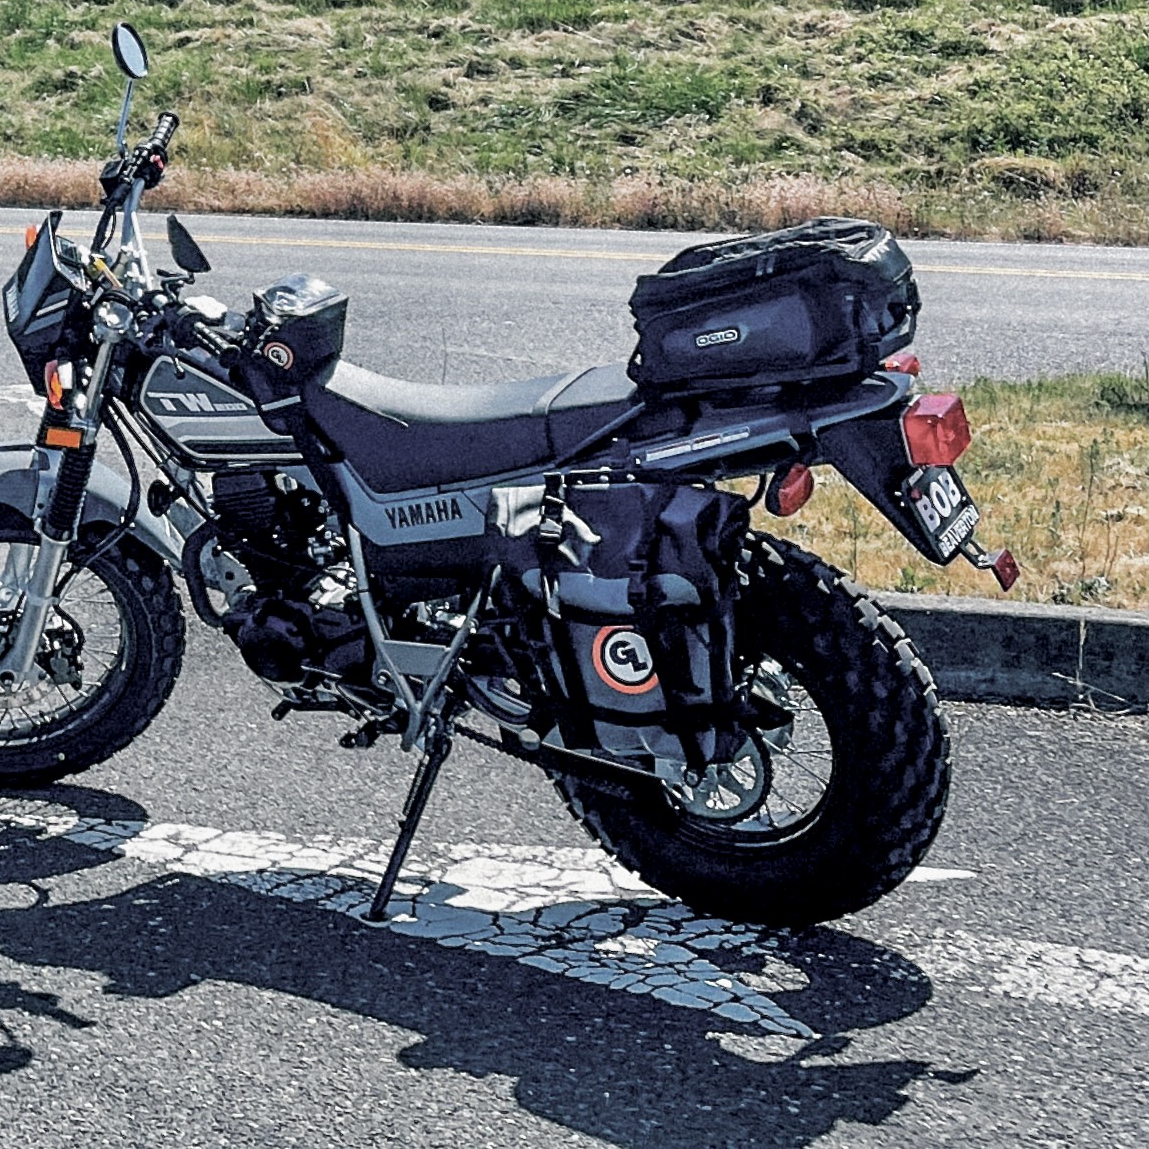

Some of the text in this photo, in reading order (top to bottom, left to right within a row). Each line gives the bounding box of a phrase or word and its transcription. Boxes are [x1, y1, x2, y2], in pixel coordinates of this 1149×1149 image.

[696, 330, 738, 347] OGIO
[385, 497, 464, 529] YAMAHA
[915, 470, 962, 533] BOB
[938, 504, 980, 558] BEAVERTON
